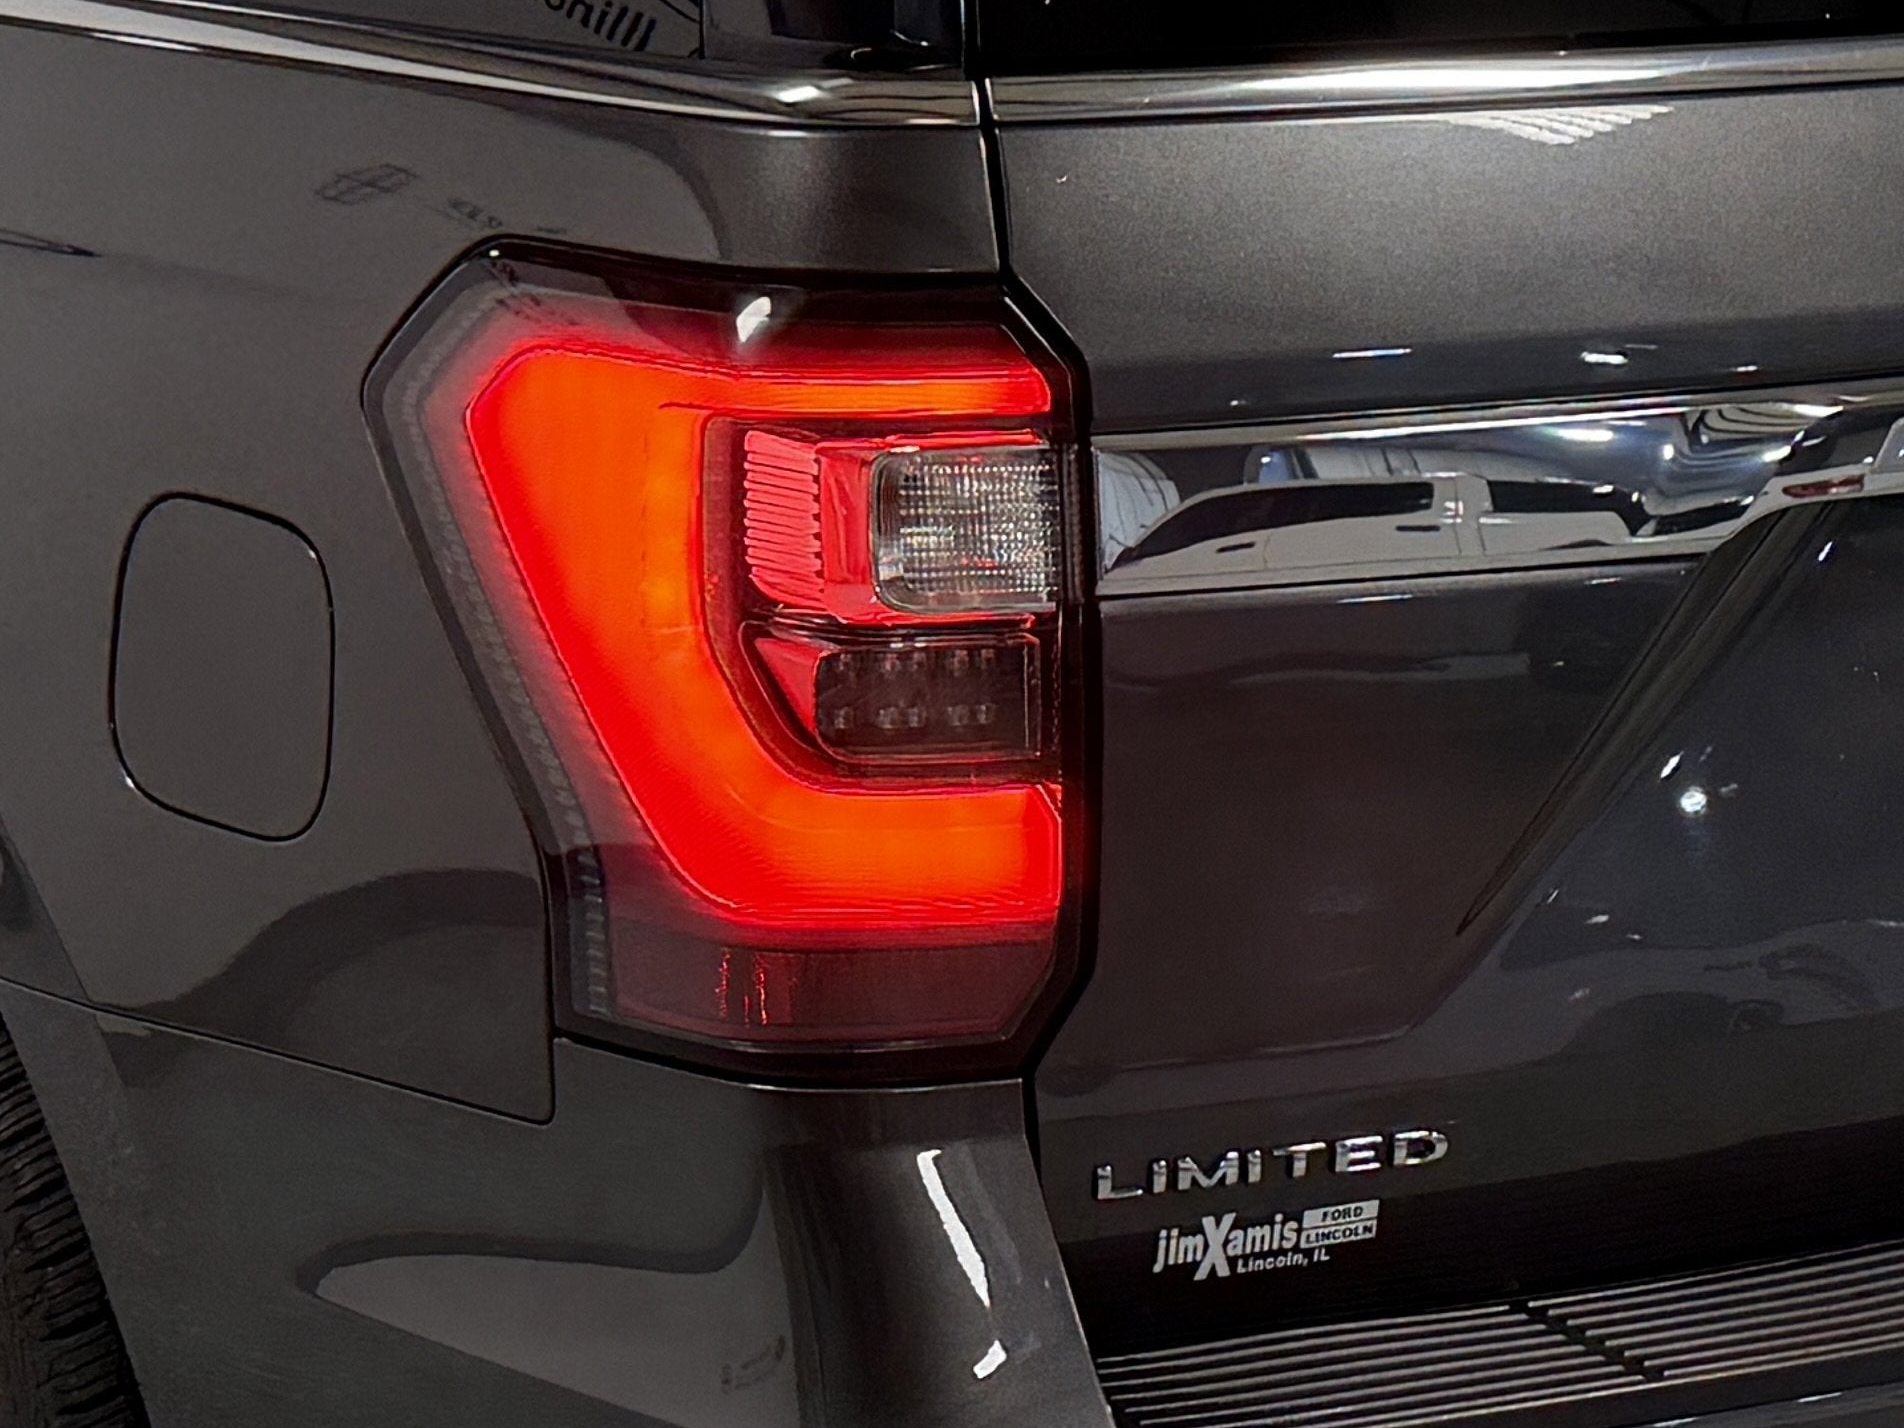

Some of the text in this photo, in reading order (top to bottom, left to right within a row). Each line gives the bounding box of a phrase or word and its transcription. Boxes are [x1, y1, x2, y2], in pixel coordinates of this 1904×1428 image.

[1096, 1129, 1450, 1201] LIMITED
[1321, 1205, 1365, 1223] FORD
[1304, 1223, 1375, 1245] LINCOLN
[1236, 1247, 1331, 1274] Lincoln, IL
